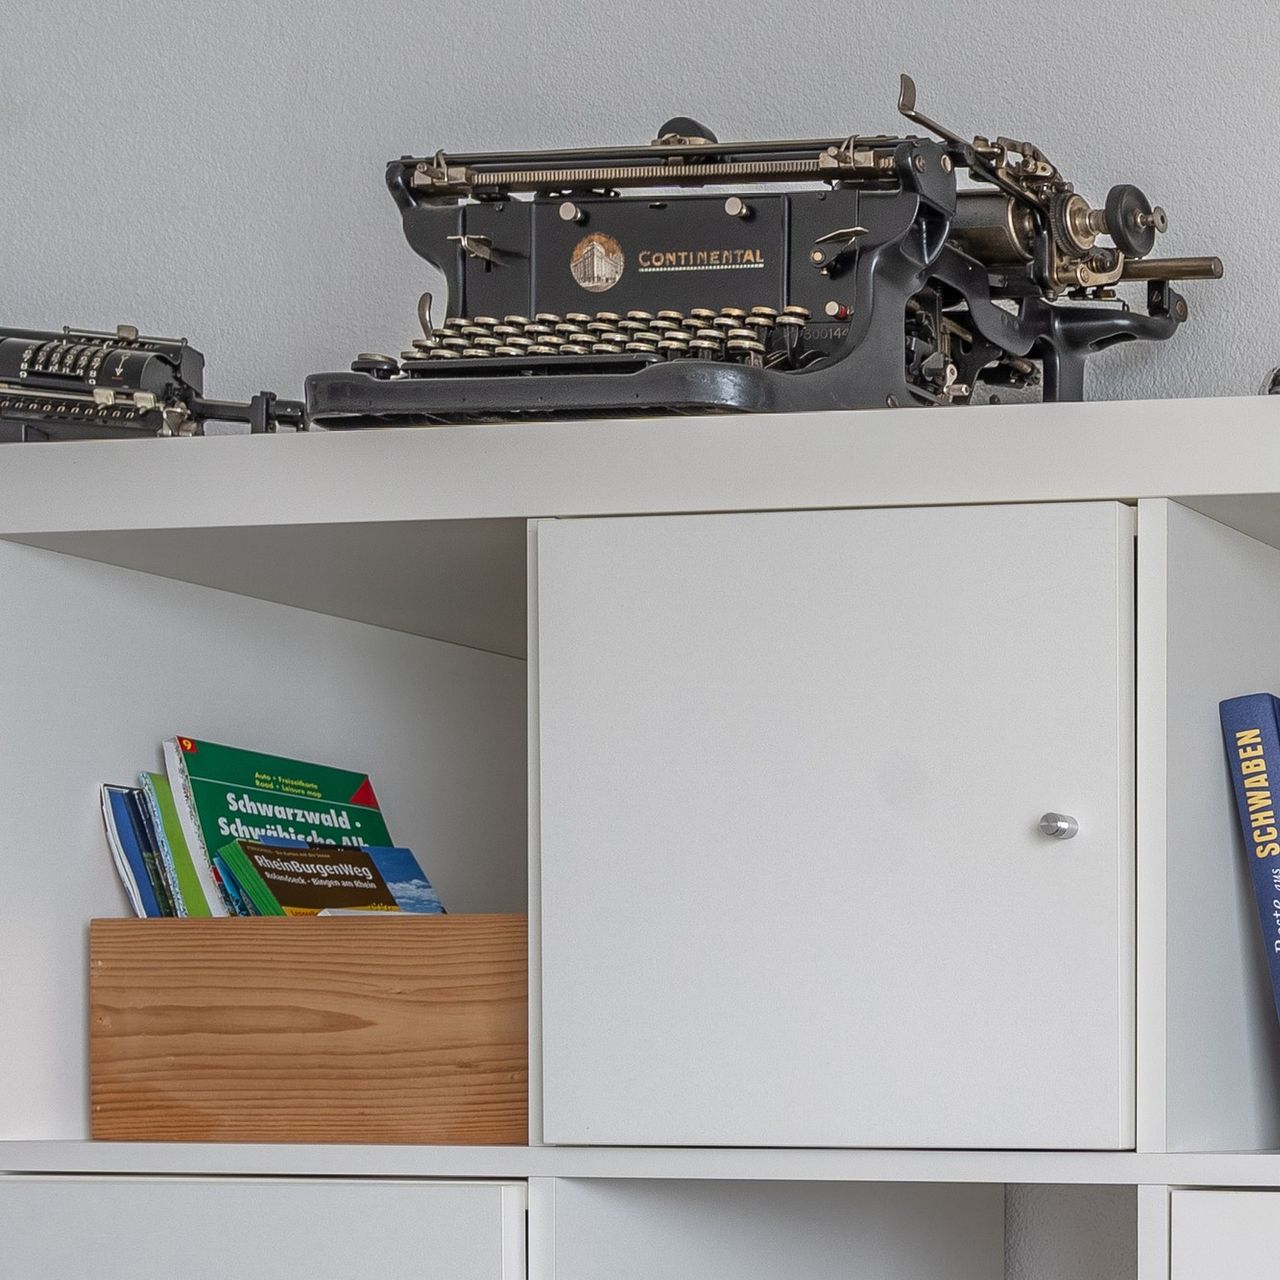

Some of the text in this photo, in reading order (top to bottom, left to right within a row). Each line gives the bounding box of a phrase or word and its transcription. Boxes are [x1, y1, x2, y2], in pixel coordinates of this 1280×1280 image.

[638, 249, 764, 268] CONTINENTAL
[181, 739, 193, 751] 9
[1236, 728, 1280, 859] SCHWABEN
[226, 792, 351, 830] Schwarzwald
[254, 855, 373, 880] RheinBurgenWeg
